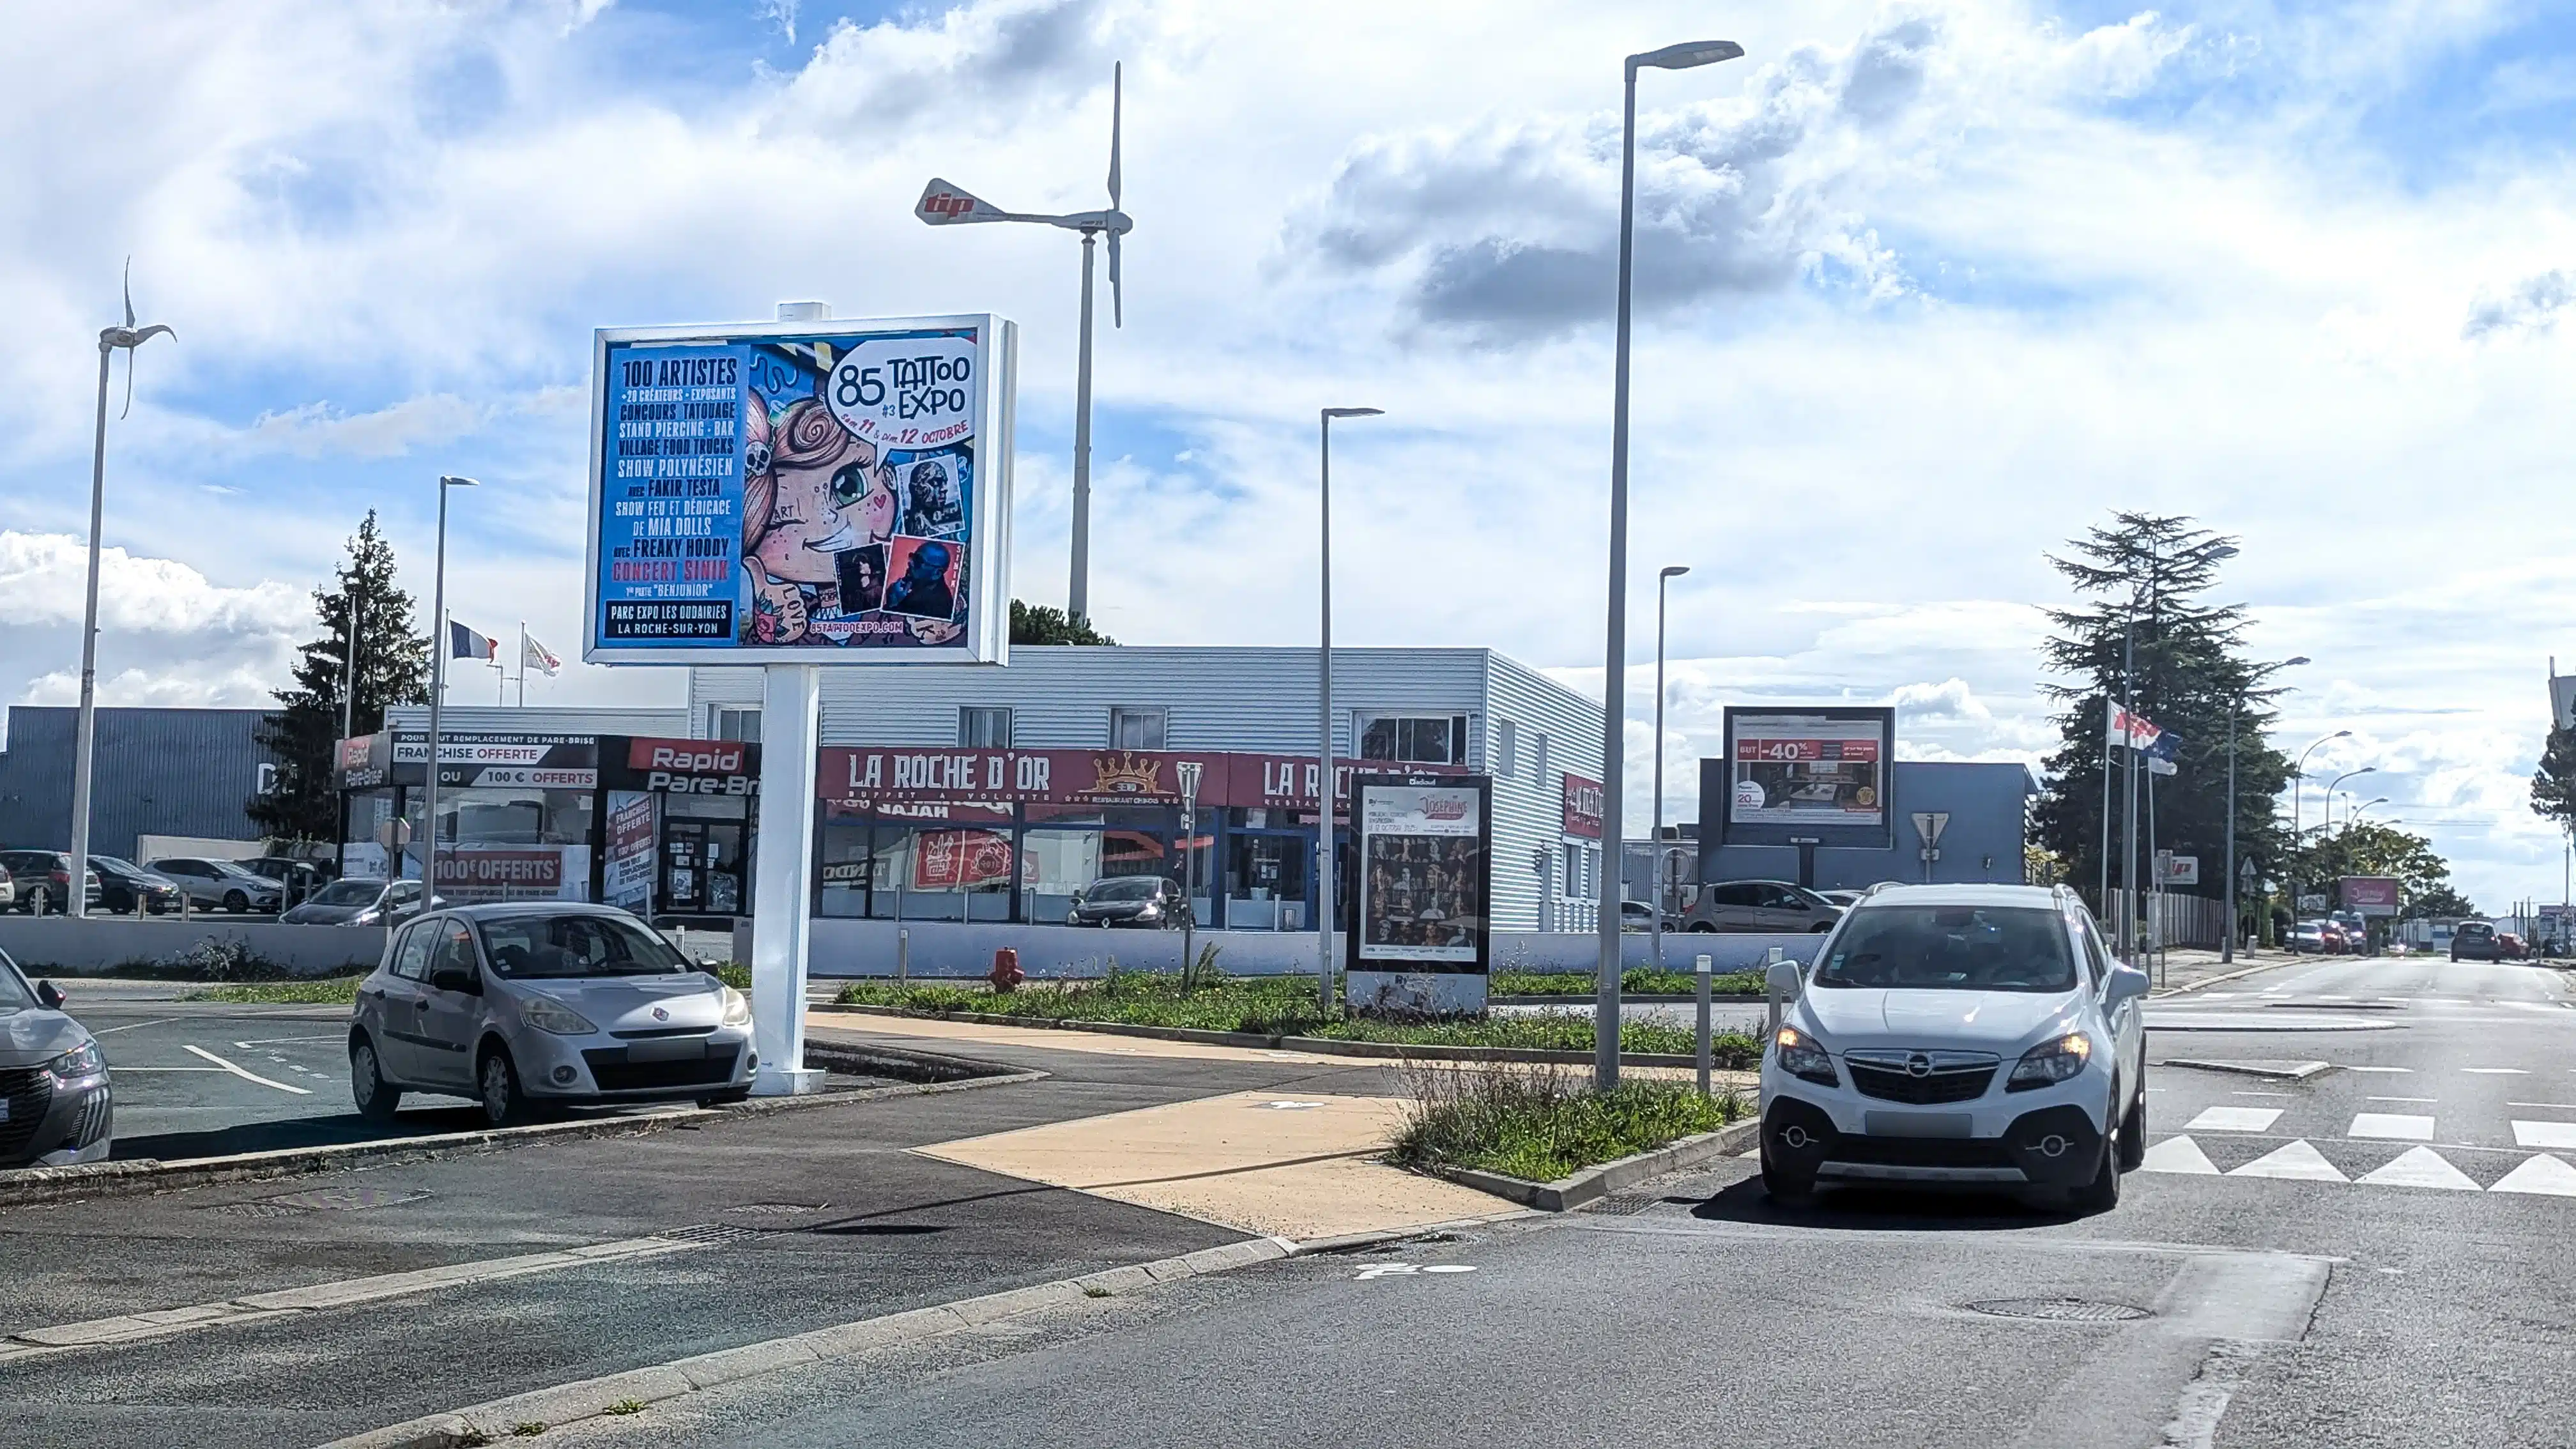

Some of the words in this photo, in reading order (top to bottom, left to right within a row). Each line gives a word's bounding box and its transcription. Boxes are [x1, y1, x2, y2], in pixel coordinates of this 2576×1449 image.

[622, 360, 653, 387] 100
[658, 358, 737, 387] ARTISTES
[639, 388, 683, 402] CRÉATEURS
[691, 387, 736, 401] EXPOSANTS
[836, 364, 885, 408] 85
[620, 403, 677, 421] CONCOURS
[683, 402, 736, 420] TATOUAGE
[898, 386, 965, 419] EXPO
[619, 422, 652, 438] STAND
[655, 421, 704, 437] PIERCING
[714, 420, 735, 436] BAR
[900, 428, 919, 444] 12
[921, 419, 969, 444] OCTOBRE
[618, 440, 659, 456] VILLAGE
[663, 438, 690, 455] FOOD
[693, 438, 734, 455] TRUCKS
[618, 459, 654, 478] SHOW
[659, 456, 733, 477] POLYNÉSIEN
[648, 479, 683, 497] FAKIR
[687, 478, 720, 496] TESTA
[615, 502, 645, 516] SHOW
[648, 500, 665, 516] FEU
[670, 500, 680, 515] ET
[684, 498, 732, 516] DÉDICACE
[633, 521, 645, 536] DE
[648, 518, 671, 535] MIA
[675, 517, 712, 535] DOLLS
[633, 539, 683, 558] FREAKY
[686, 537, 730, 557] HOODY
[612, 561, 677, 581] CONCERT
[684, 560, 728, 581] SINIK
[611, 606, 634, 620] PARC
[636, 606, 659, 620] EXPO
[662, 605, 677, 619] LES
[618, 624, 631, 634] LA
[634, 623, 718, 634] ROCHE-SUR-YON
[477, 748, 537, 760] OFFERTE
[652, 747, 740, 772] Rapid
[1739, 746, 1757, 754] BUT
[440, 771, 461, 783] OU
[487, 771, 510, 783] 100
[514, 771, 525, 783] €
[848, 754, 884, 789] LA
[892, 753, 977, 790] ROCHE
[986, 753, 1050, 792] D'OR
[1264, 761, 1294, 797] LA
[617, 811, 651, 836] OFFERTE
